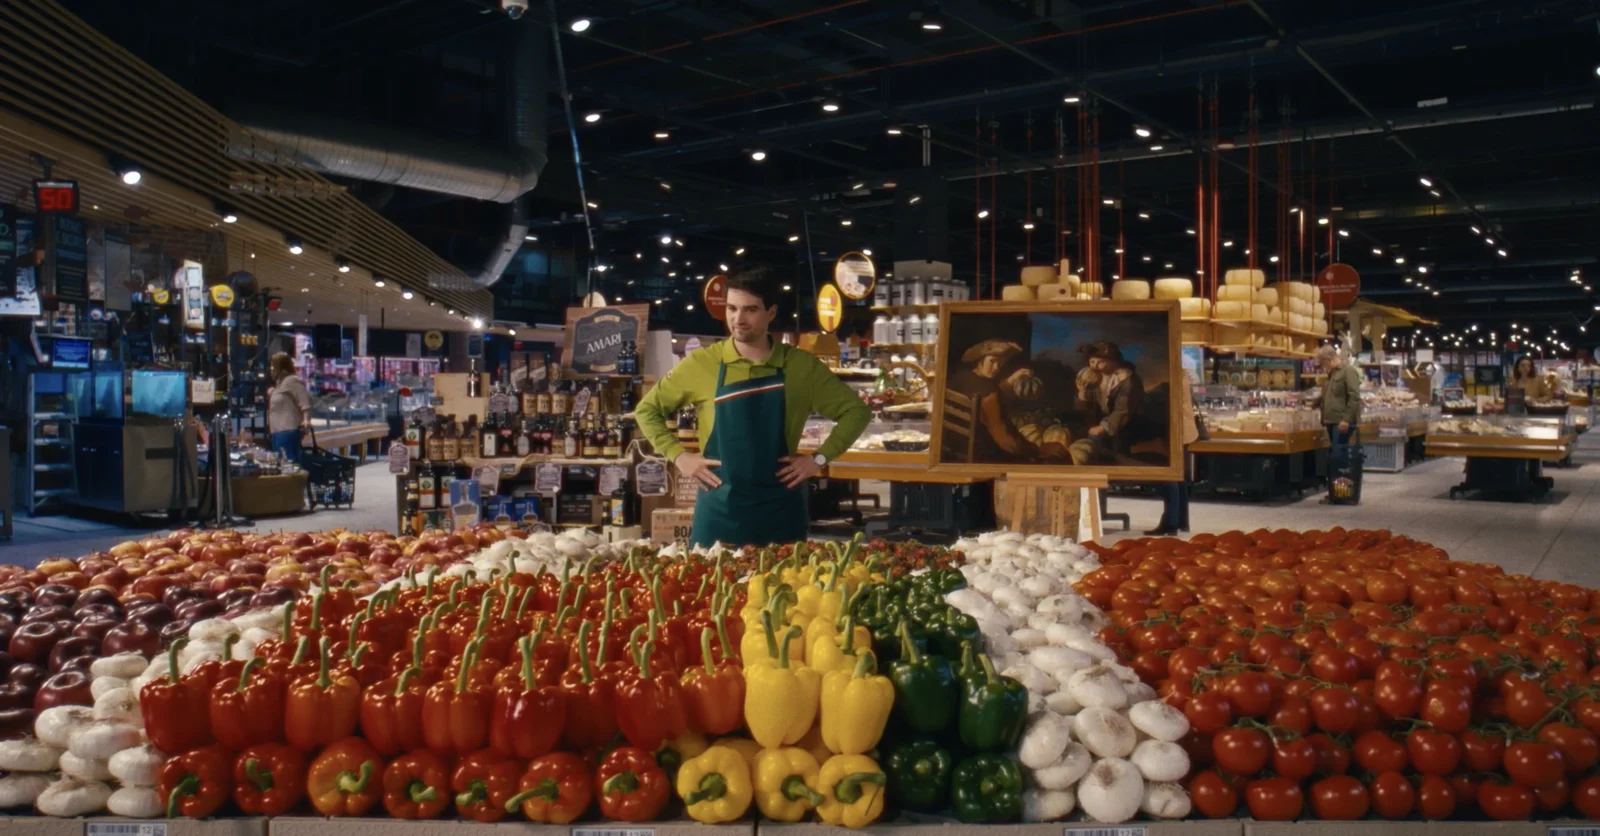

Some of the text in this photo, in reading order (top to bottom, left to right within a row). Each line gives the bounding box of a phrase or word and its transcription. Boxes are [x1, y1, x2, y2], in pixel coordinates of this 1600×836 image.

[40, 188, 73, 210] 50
[586, 333, 622, 354] AMARI
[142, 825, 152, 835] 12
